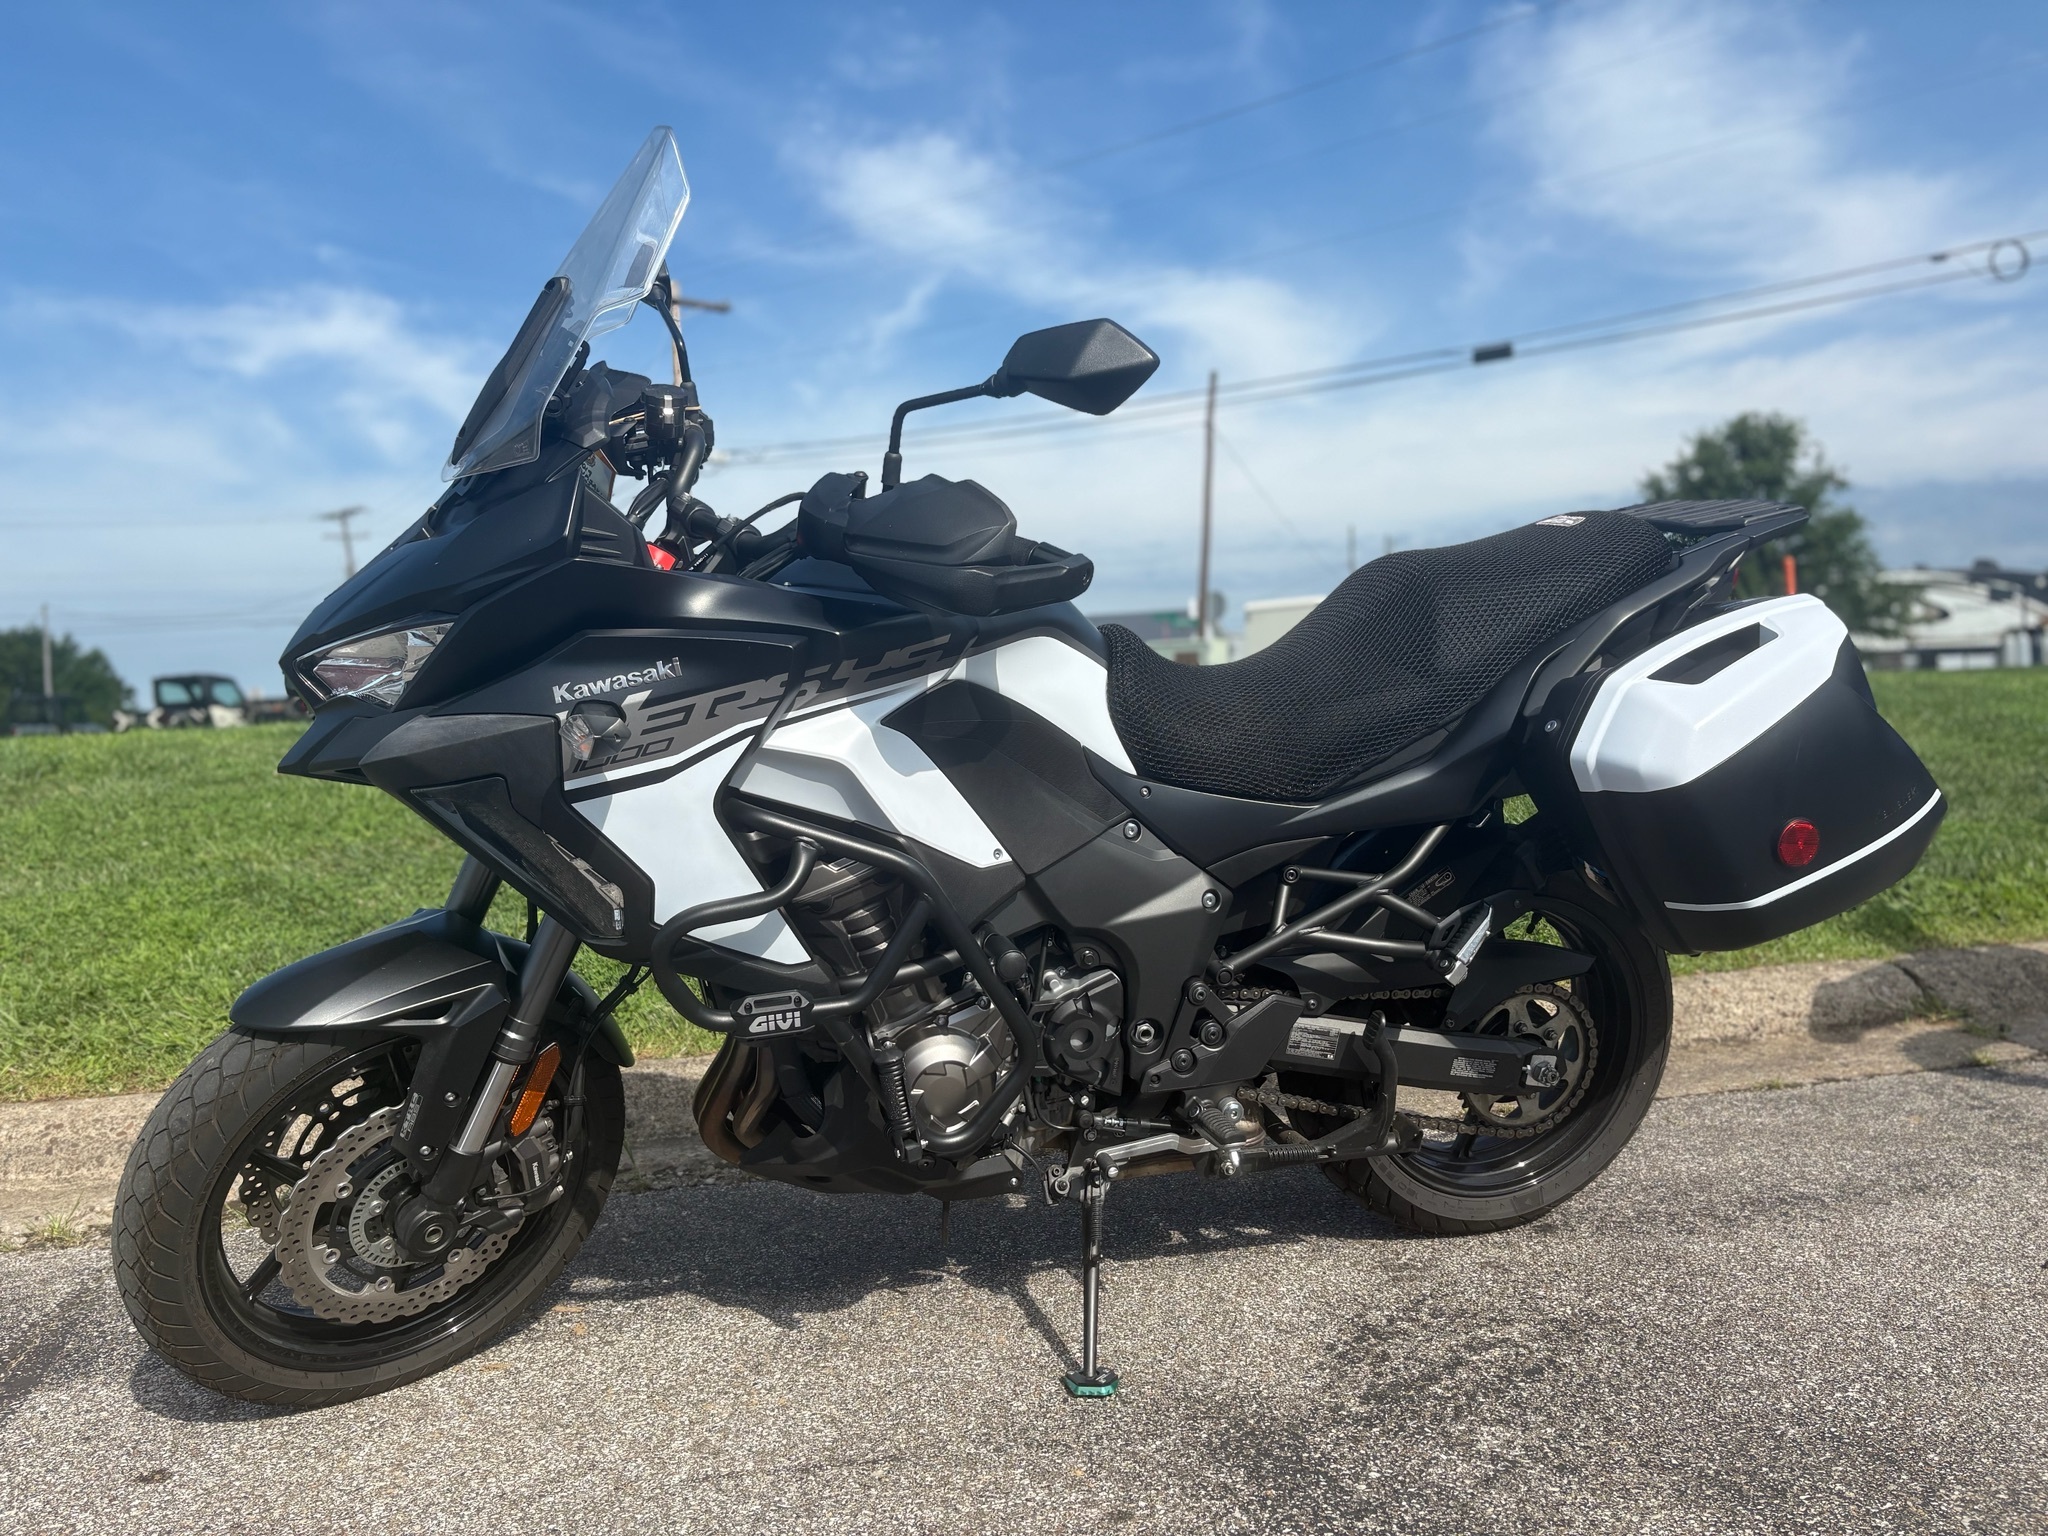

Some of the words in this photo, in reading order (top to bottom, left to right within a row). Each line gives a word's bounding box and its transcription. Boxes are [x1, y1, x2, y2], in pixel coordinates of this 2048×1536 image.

[552, 657, 682, 704] Kawasaki
[749, 1011, 801, 1033] GIVI
[532, 1161, 541, 1187] Kawasak
